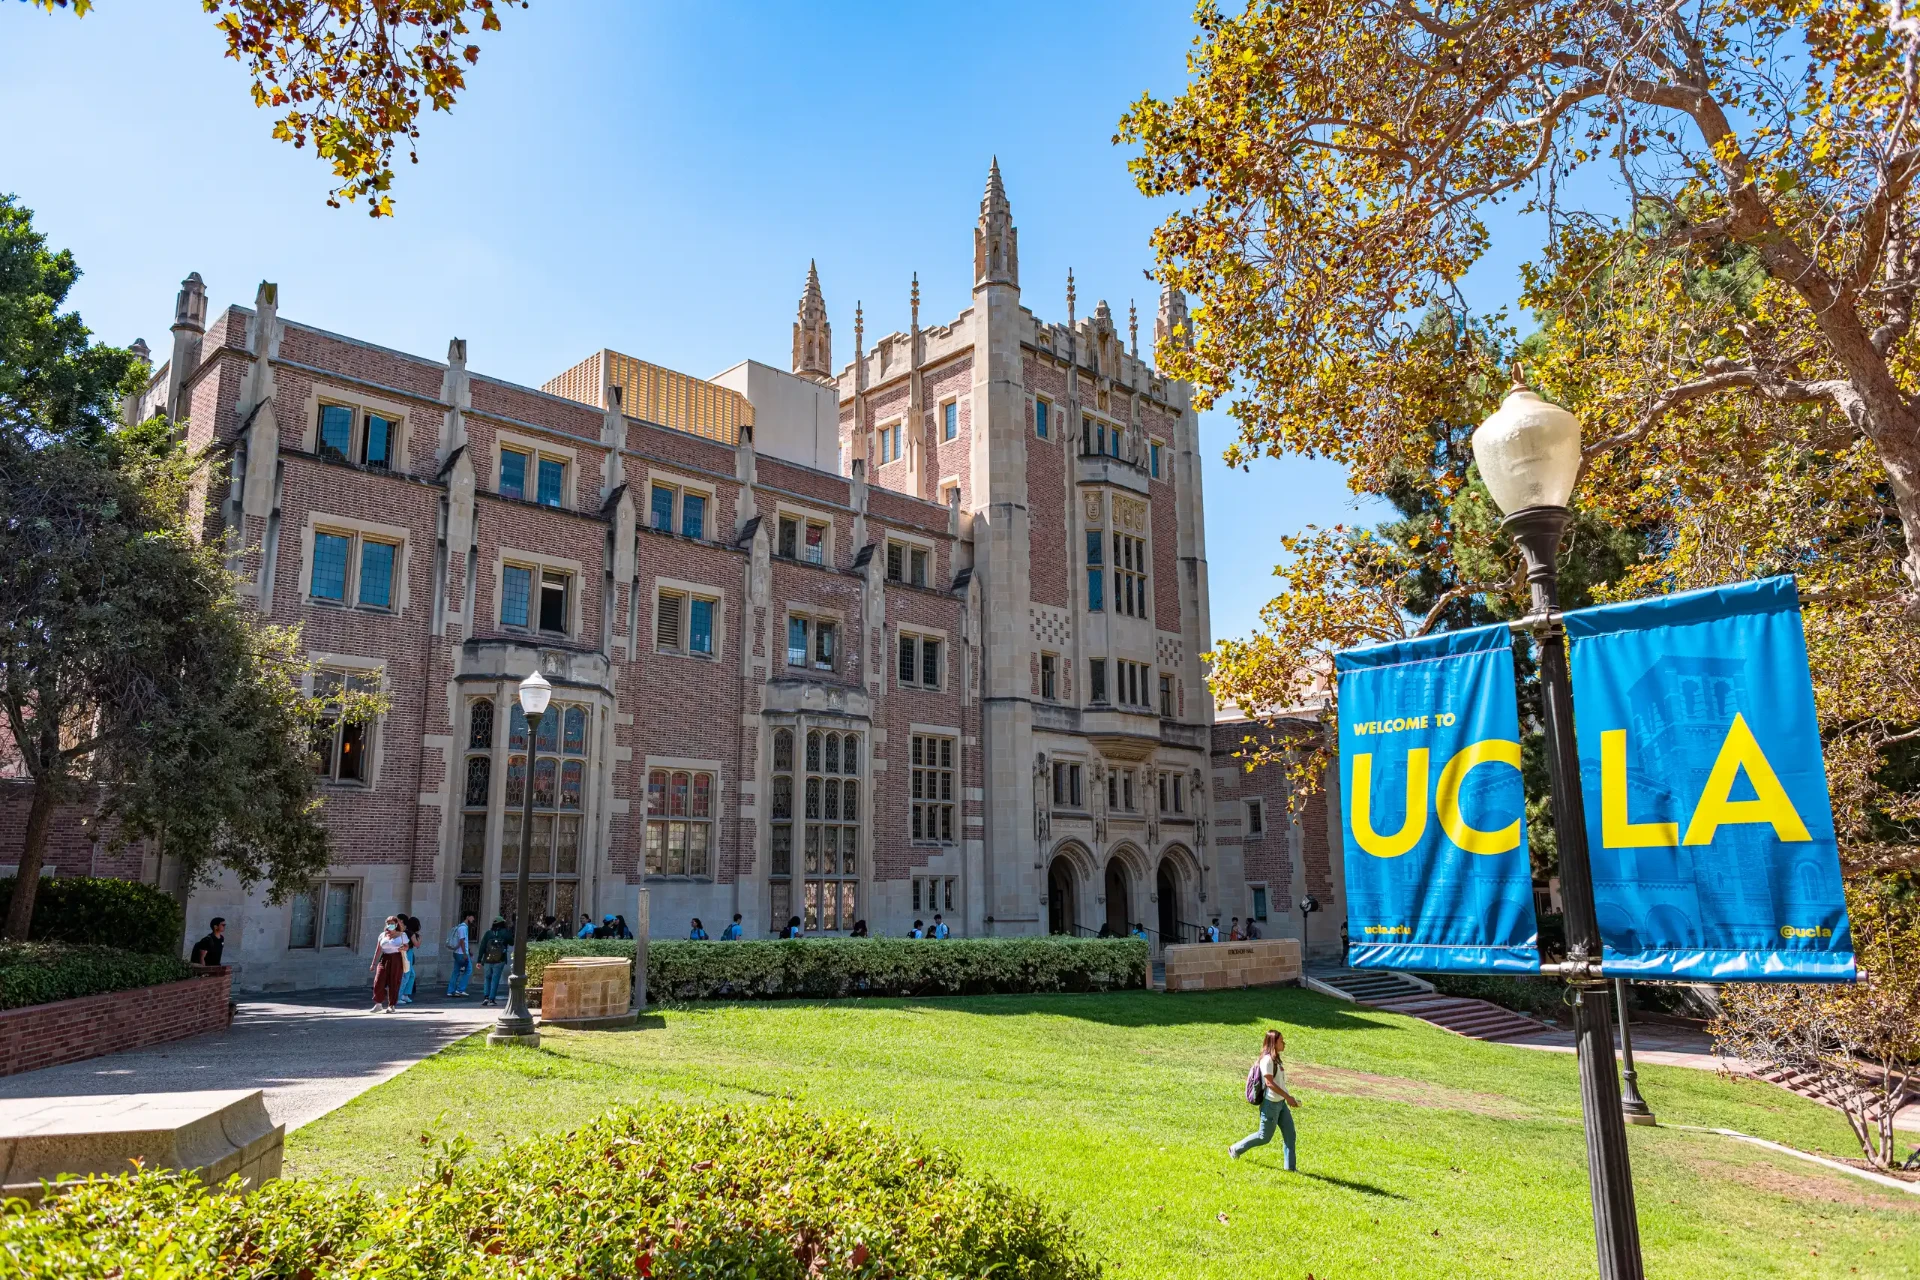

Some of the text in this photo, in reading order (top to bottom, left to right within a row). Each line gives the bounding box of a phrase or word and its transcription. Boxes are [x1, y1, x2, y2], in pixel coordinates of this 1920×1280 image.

[1353, 712, 1456, 736] WELCOME TO
[1600, 712, 1813, 848] LA
[1351, 739, 1521, 858] UC
[1364, 924, 1412, 934] ucla.edu
[1780, 925, 1832, 939] @ucla
